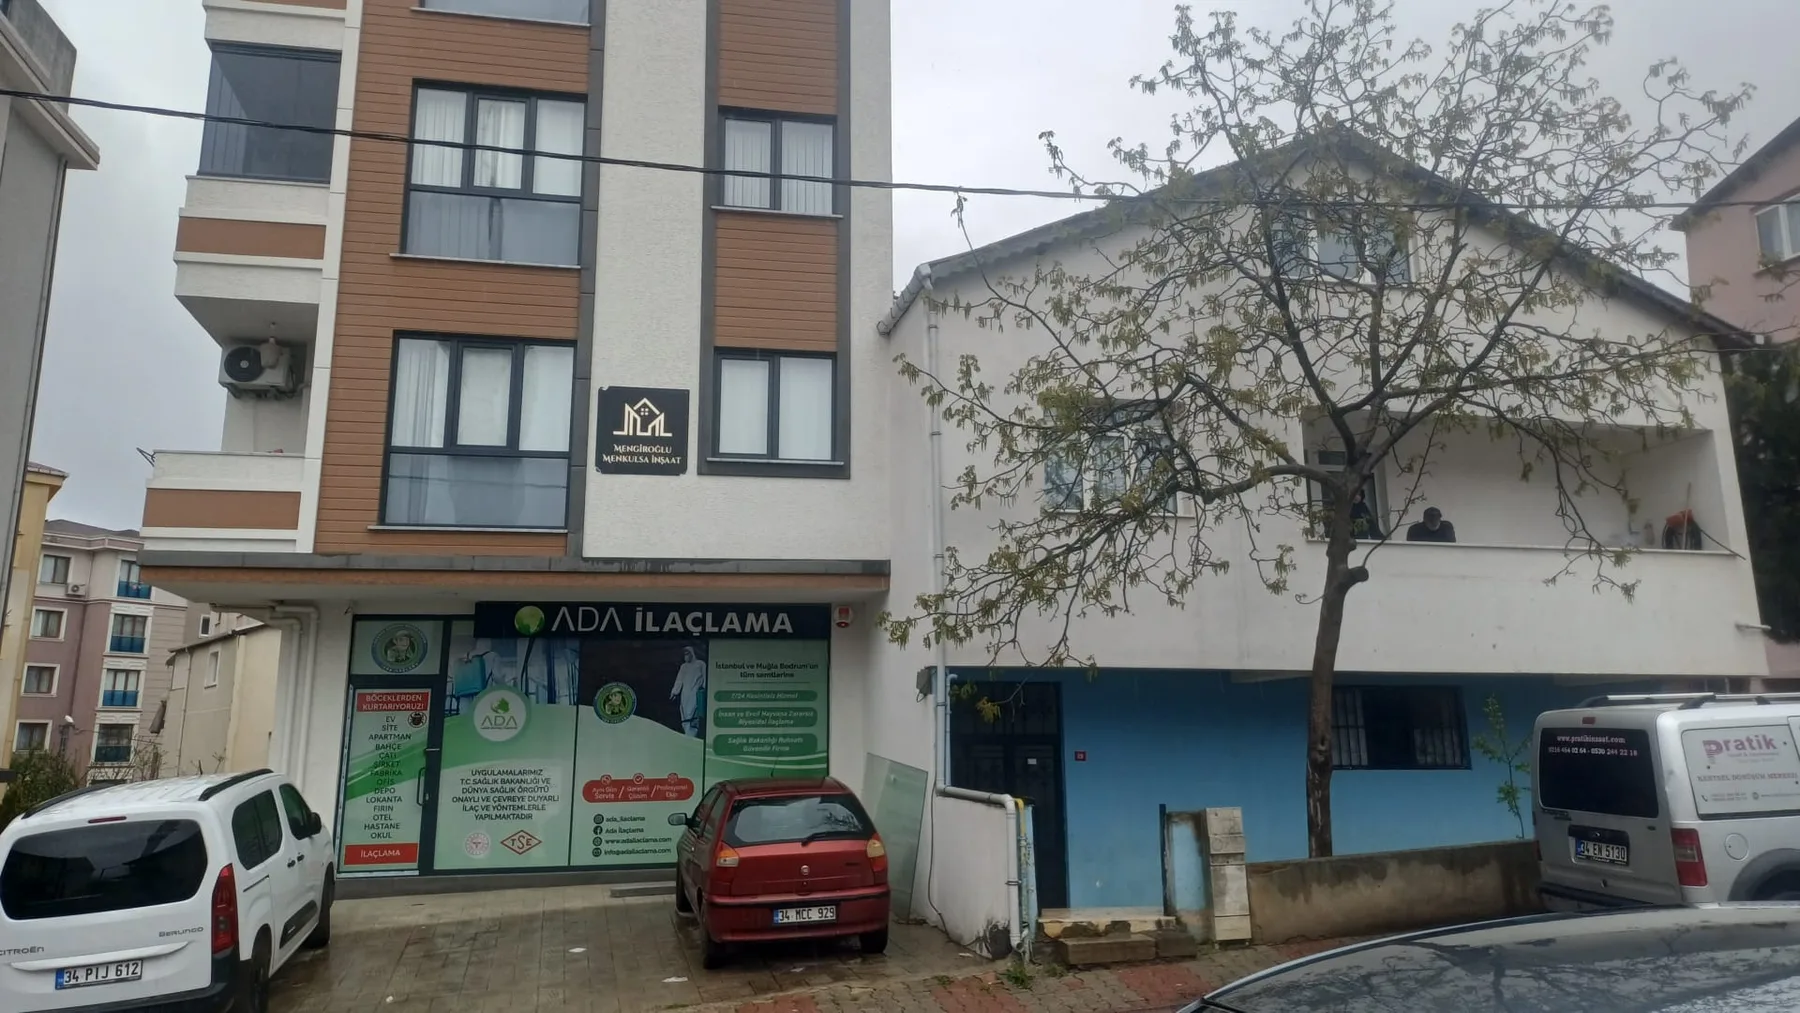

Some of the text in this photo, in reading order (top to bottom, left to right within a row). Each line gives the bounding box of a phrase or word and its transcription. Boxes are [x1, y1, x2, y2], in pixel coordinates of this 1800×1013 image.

[613, 444, 672, 454] MENGİROĞLU
[603, 454, 682, 465] MENKULSA İNŞAAT
[551, 606, 794, 636] ADA İLAÇLAMA
[757, 662, 778, 670] Muğla
[366, 694, 422, 702] BÖCEKLERDEN
[362, 703, 424, 711] KURTARIYORUZ!
[481, 715, 518, 727] ADA
[368, 733, 412, 741] APARTMAN
[375, 743, 402, 751] BAHÇE
[379, 752, 397, 760] ÇATI
[472, 777, 500, 785] SAĞLIK
[500, 777, 540, 785] BAKANLIĞI
[374, 787, 396, 795] DEPO
[462, 785, 549, 794] DÜNYA SAĞLIK ÖRGÜTÜ
[366, 796, 403, 804] LOKANTA
[492, 796, 526, 804] ÇEVREYE
[462, 804, 478, 812] İLAÇ
[492, 803, 546, 811] YÖNTEMLERLE
[474, 813, 533, 821] YAPILMAKTADIR
[364, 823, 401, 831] HASTANE
[510, 834, 533, 850] TSE
[360, 849, 401, 859] İLAÇLAMA
[1580, 841, 1590, 854] 34
[1592, 844, 1603, 856] EN
[1605, 846, 1626, 860] 5130
[779, 907, 835, 922] 34 MCC 929
[64, 962, 139, 984] 34 PIJ 612
